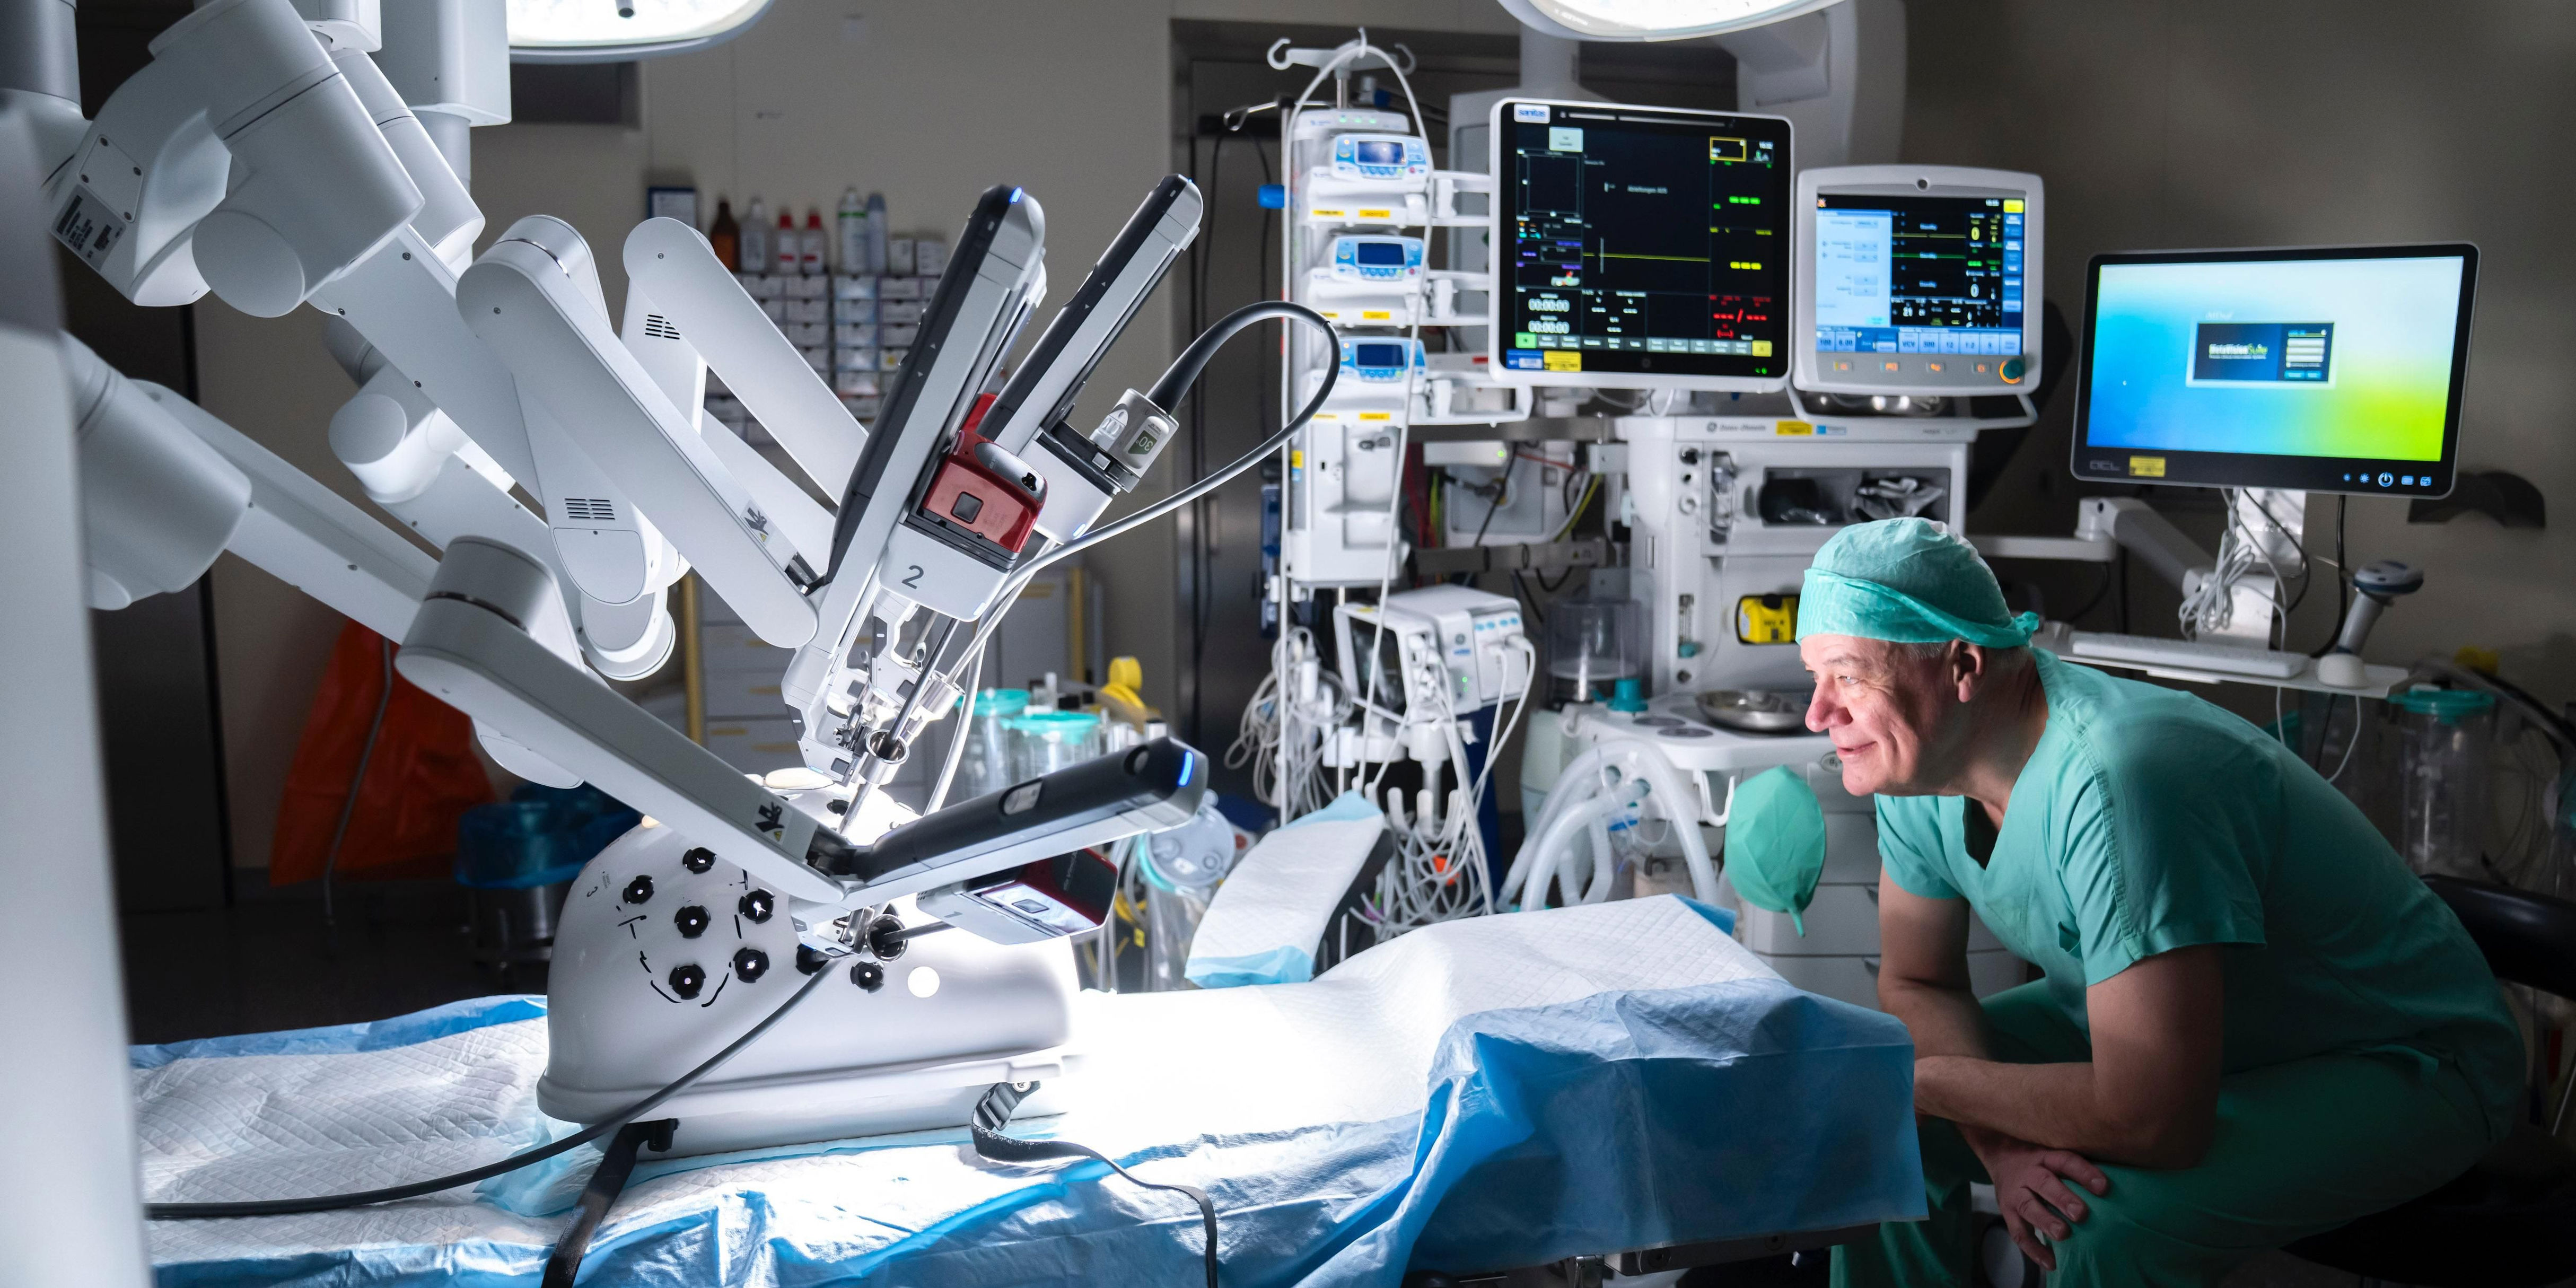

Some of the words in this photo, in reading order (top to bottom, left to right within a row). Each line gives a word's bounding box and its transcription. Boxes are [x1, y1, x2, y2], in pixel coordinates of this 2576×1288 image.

[1518, 109, 1546, 117] sanitas
[1135, 436, 1153, 451] 30°
[901, 565, 924, 590] 2
